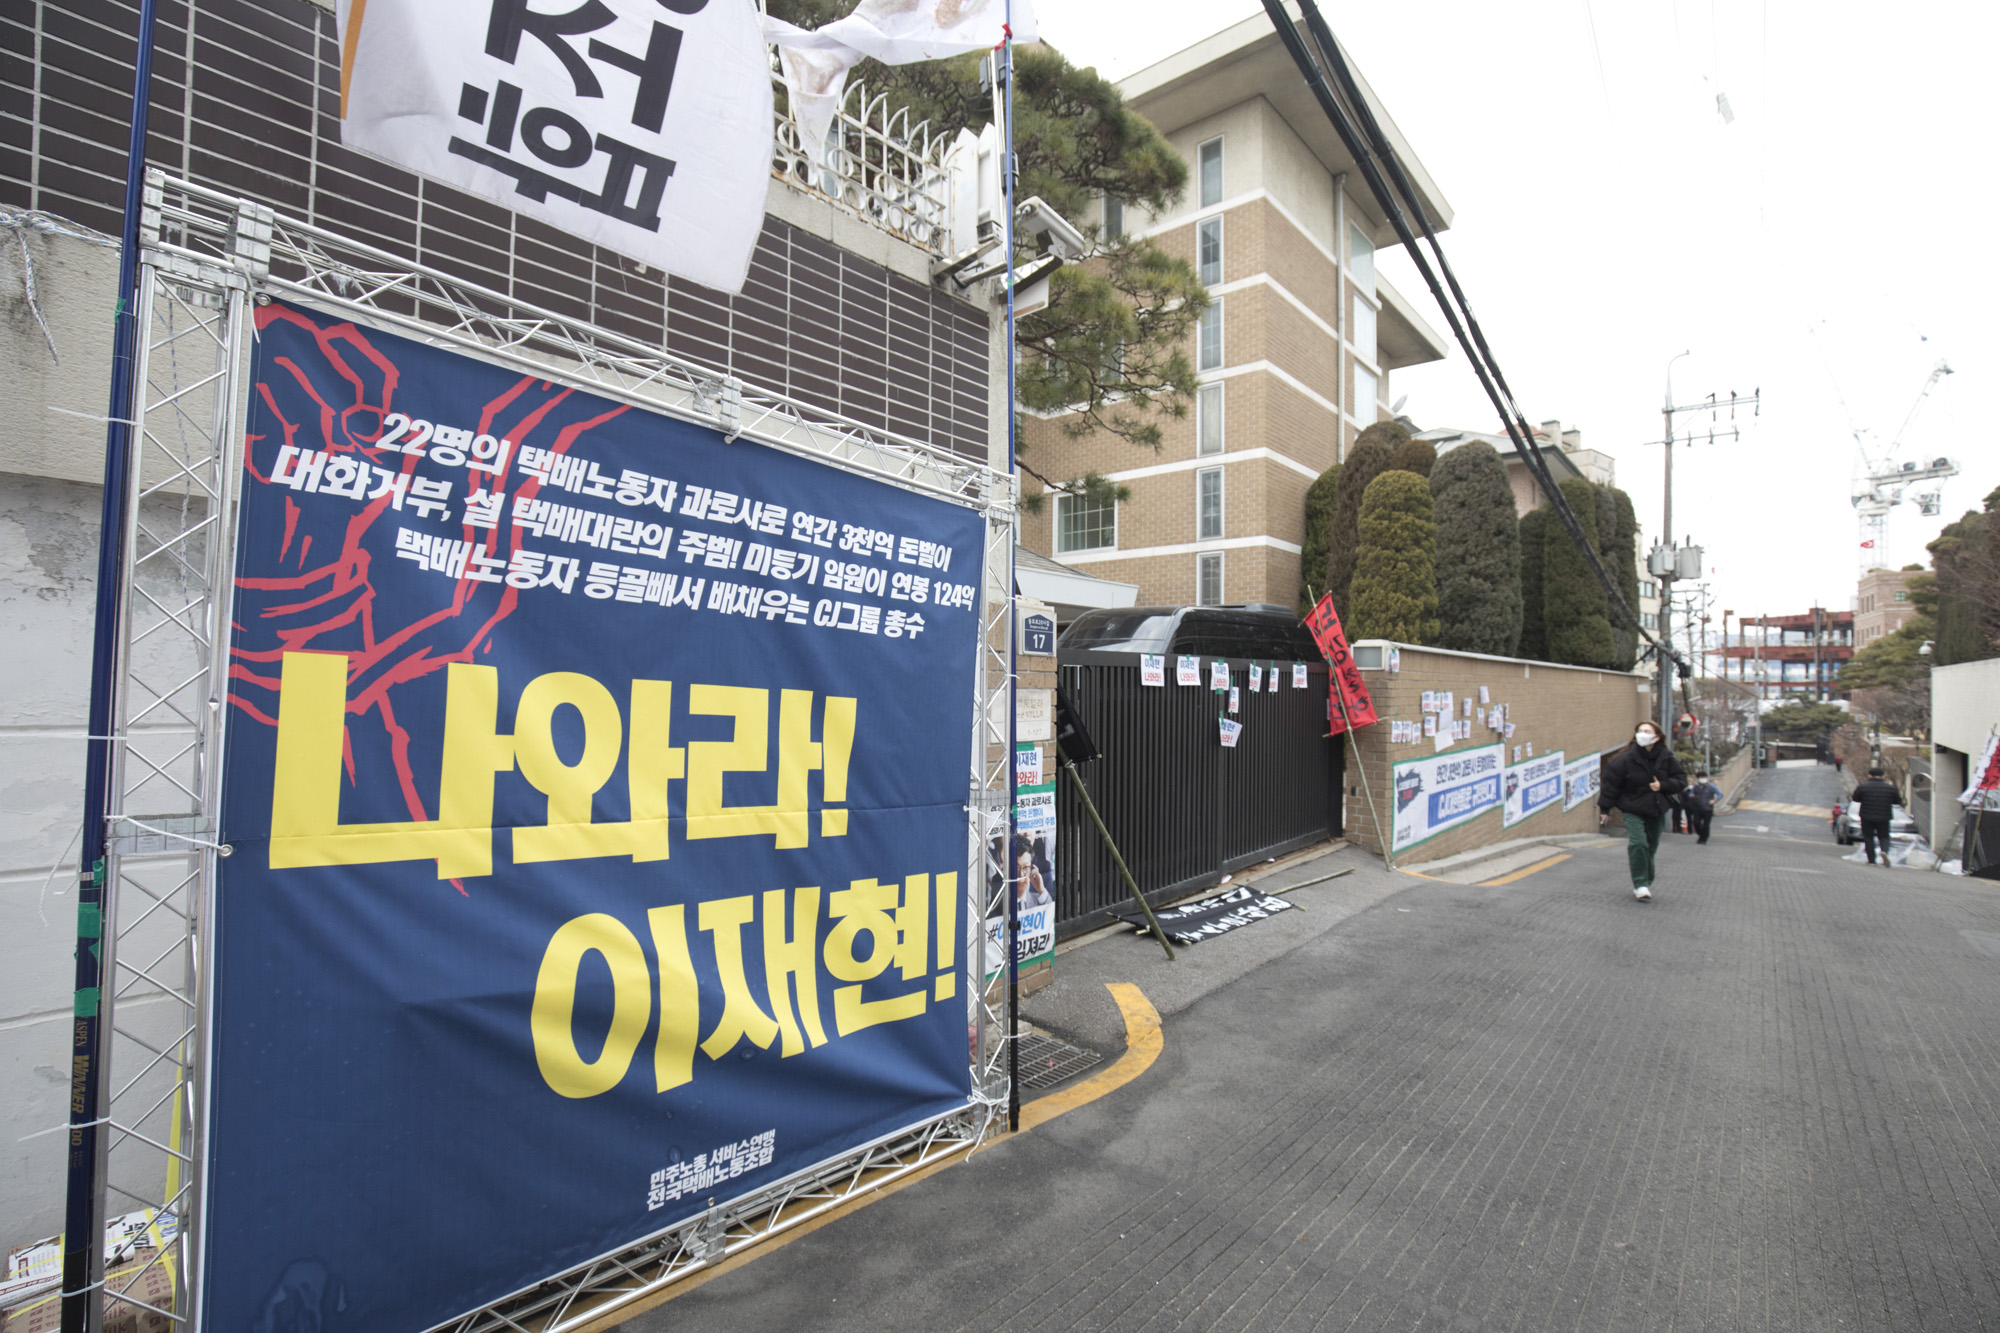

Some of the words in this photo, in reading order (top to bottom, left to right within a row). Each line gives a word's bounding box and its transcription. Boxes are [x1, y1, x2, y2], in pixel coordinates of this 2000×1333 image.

[270, 444, 451, 522] 대화거부,
[462, 488, 505, 529] 설
[511, 496, 674, 560] 택배대란의
[677, 529, 743, 570] 주범!
[742, 542, 820, 585] 미등기
[823, 558, 888, 597] 임원이
[890, 571, 930, 604] 연봉
[932, 581, 976, 612] 124억
[375, 412, 511, 476] 22명의
[517, 444, 678, 513] 택배노동자
[679, 484, 788, 536] 과로사로
[791, 511, 837, 549] 연간
[838, 524, 894, 560] 3천억
[898, 536, 952, 572] 돈벌이
[395, 526, 580, 594] 택배노동자
[583, 561, 706, 611] 등골빼서
[706, 580, 810, 625] 배채우는
[813, 598, 882, 635] CJ그룹
[883, 609, 926, 640] 총수
[1033, 633, 1046, 649] 17
[269, 651, 857, 880] 나와라!
[531, 871, 957, 1099] 이재현!
[75, 1020, 88, 1048] ASPEN
[72, 1054, 90, 1114] WINNER
[647, 1146, 775, 1212] 전국택배노동조합
[650, 1153, 708, 1190] 민주노총
[709, 1128, 776, 1166] 서비스연맹
